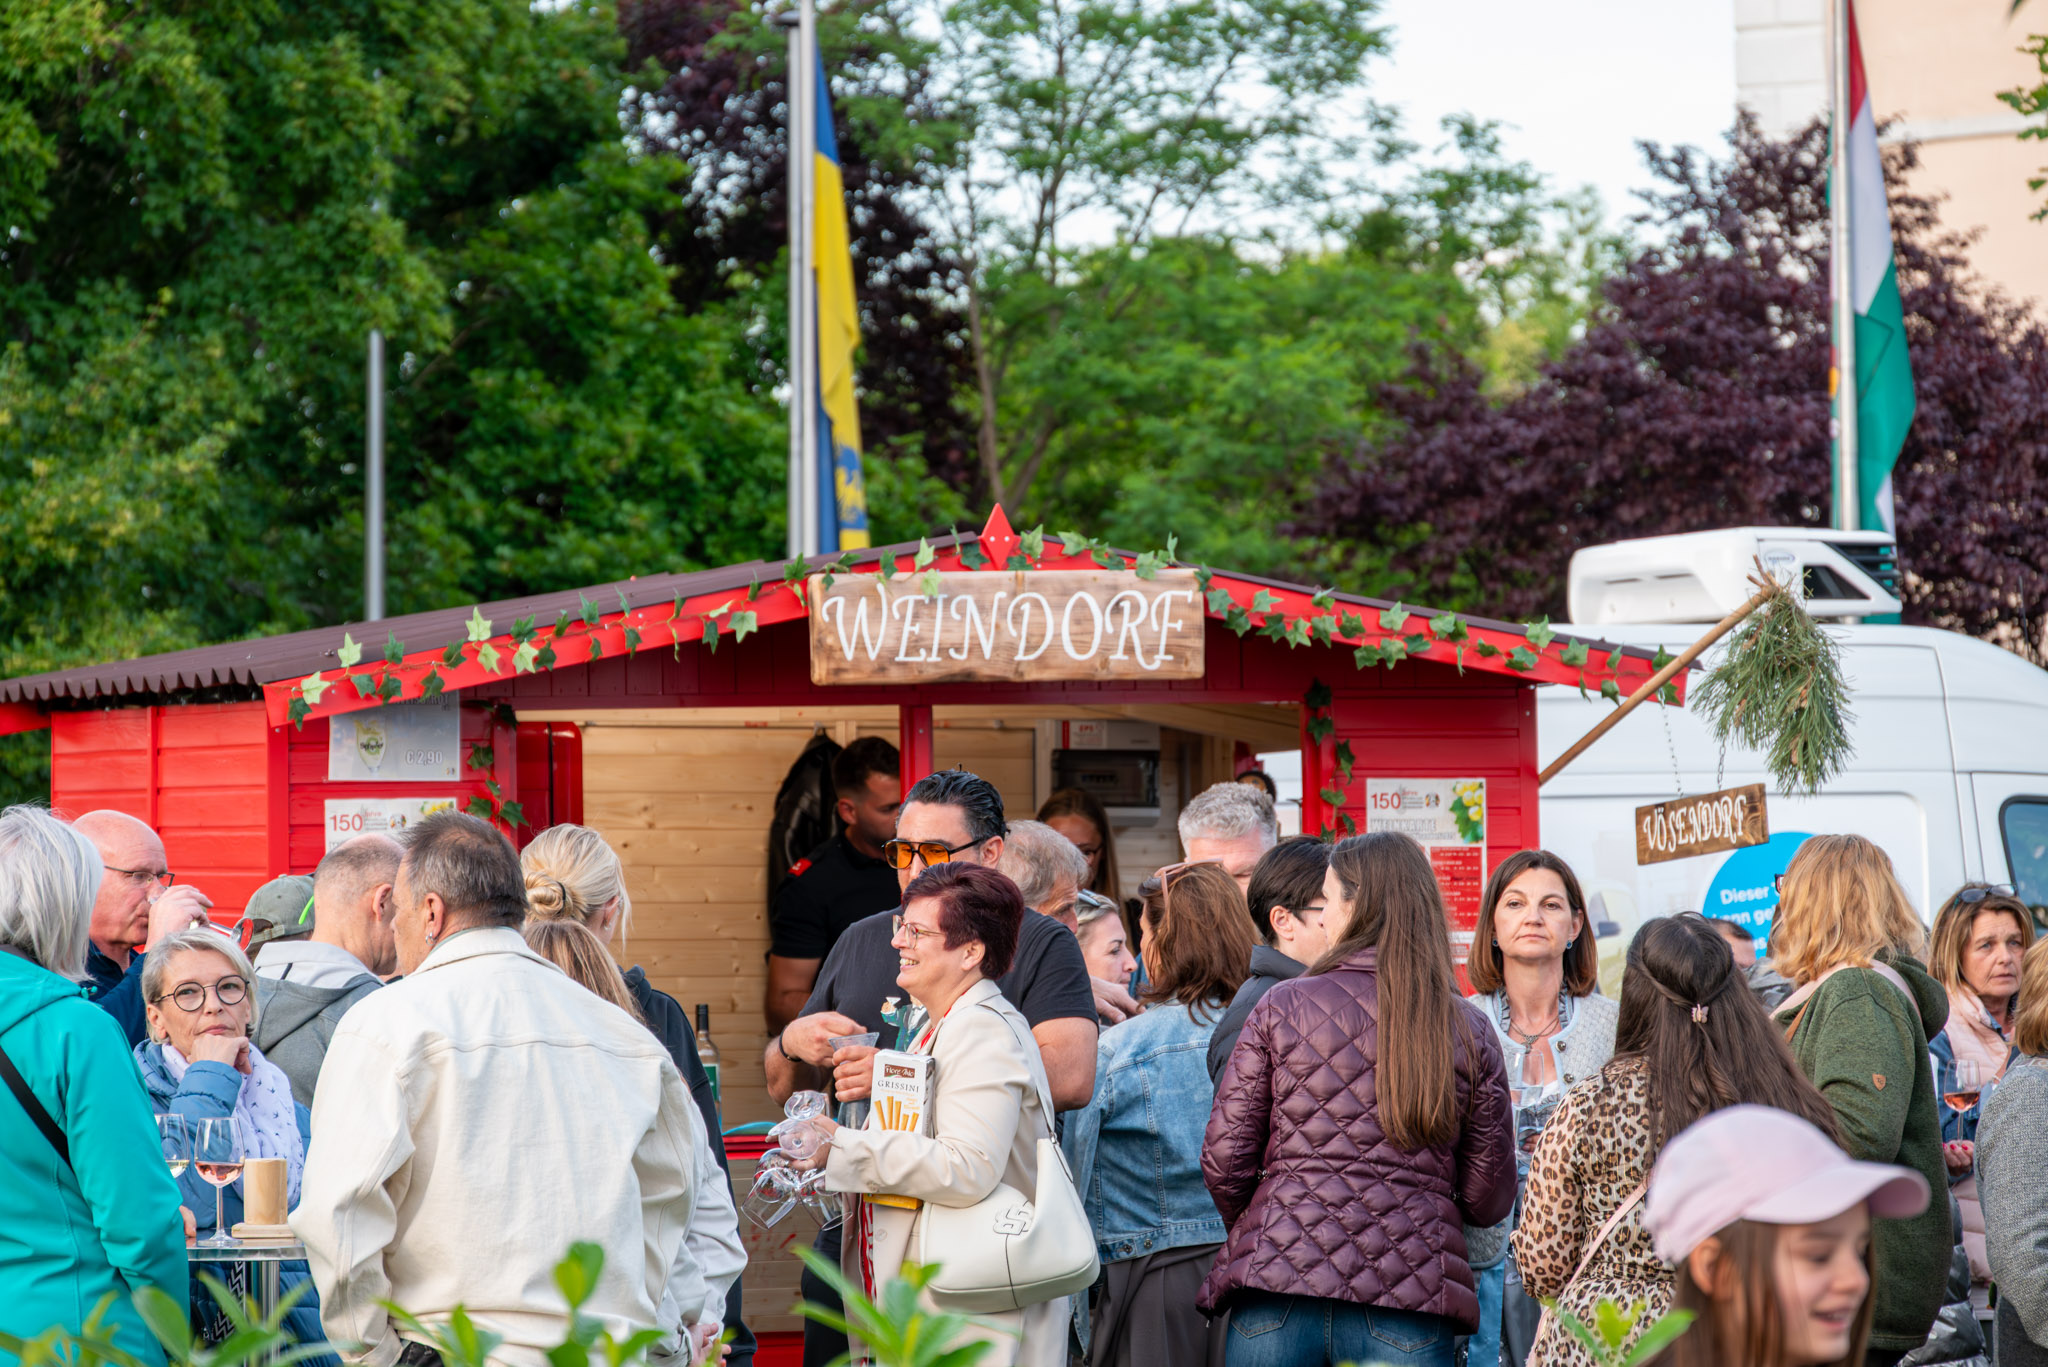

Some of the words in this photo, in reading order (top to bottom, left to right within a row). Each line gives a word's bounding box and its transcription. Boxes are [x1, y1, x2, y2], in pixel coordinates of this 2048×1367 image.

[822, 583, 1193, 670] WEINDORF
[417, 750, 443, 766] 2,90
[1371, 792, 1401, 809] 150
[329, 813, 363, 831] 150
[1643, 795, 1747, 852] VÖSENDORF
[1720, 886, 1770, 905] Dieser
[878, 1080, 919, 1093] GRISSINI
